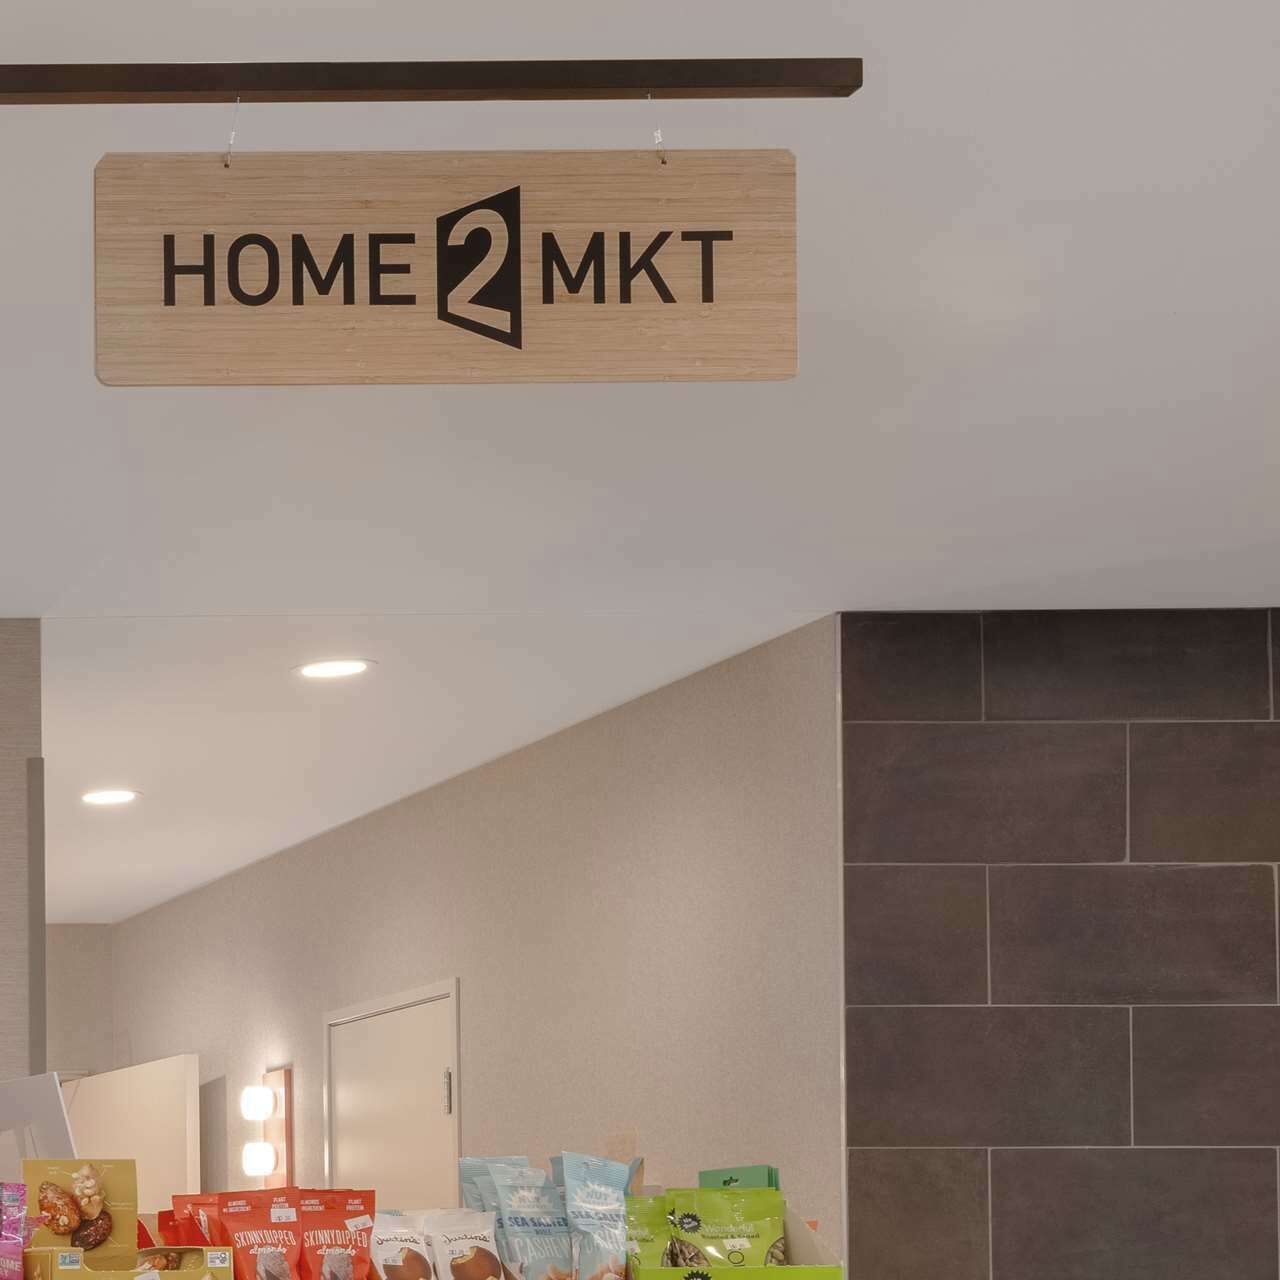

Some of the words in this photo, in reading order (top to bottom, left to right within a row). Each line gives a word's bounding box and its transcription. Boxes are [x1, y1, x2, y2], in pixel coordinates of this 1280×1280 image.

[163, 233, 416, 306] HOME
[446, 207, 513, 334] 2
[541, 229, 733, 305] MKT
[234, 1229, 296, 1248] SKINNYDIPPED
[303, 1229, 368, 1248] SKINNYDIPPED
